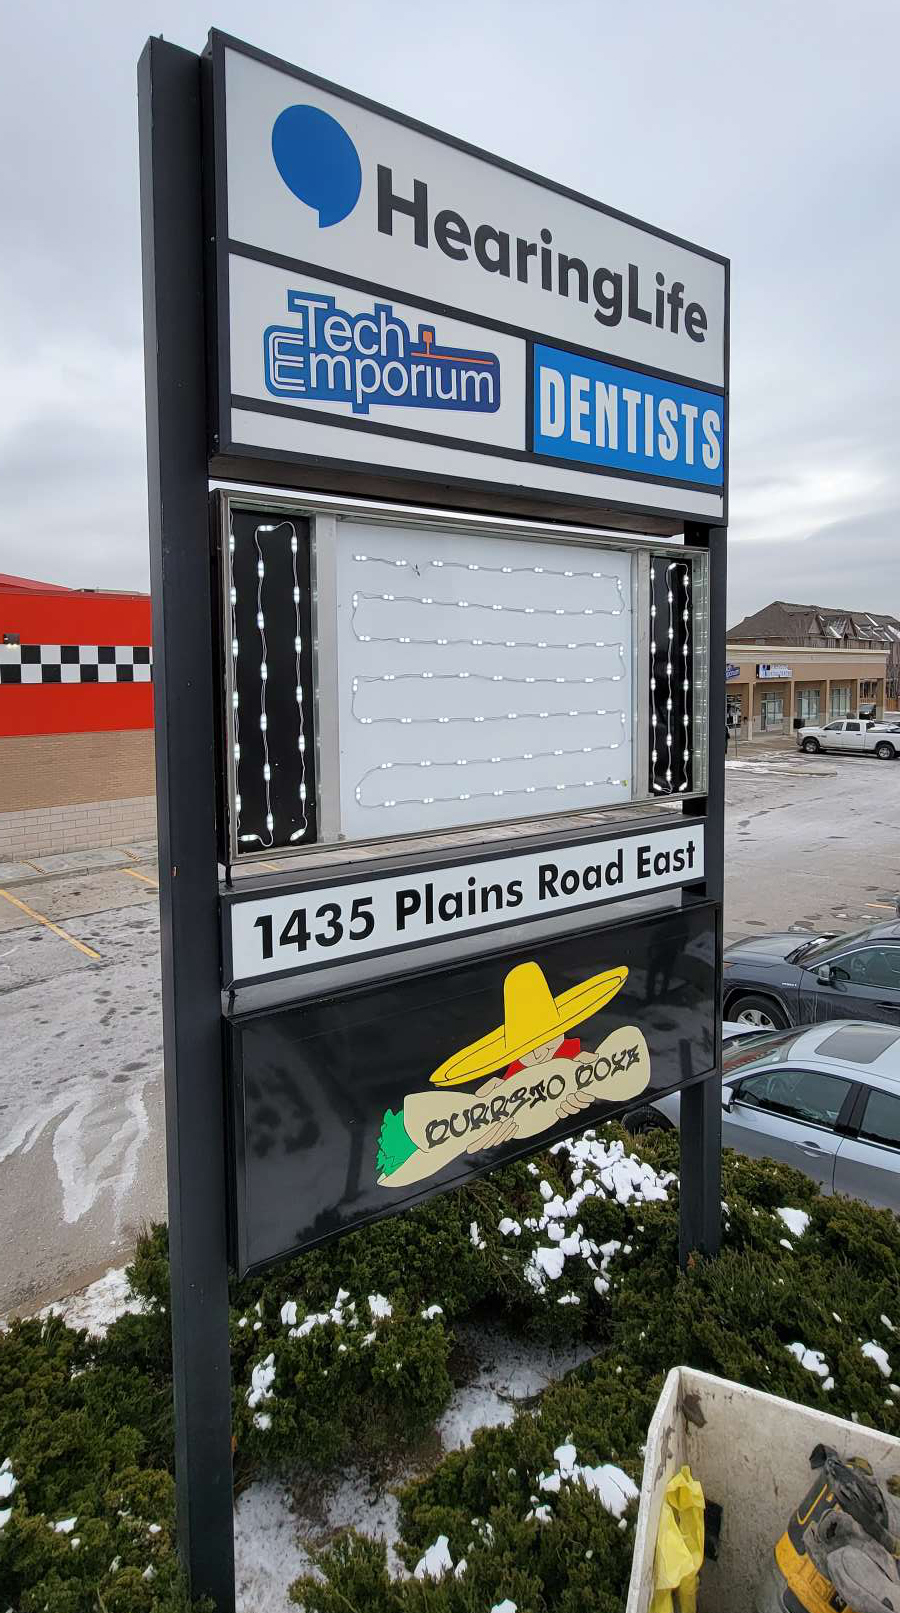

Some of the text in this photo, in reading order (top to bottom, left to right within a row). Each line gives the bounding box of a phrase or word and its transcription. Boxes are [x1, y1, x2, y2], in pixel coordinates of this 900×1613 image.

[377, 163, 708, 343] HearingLife
[268, 331, 494, 404] Emporium
[294, 298, 404, 358] Tech
[539, 365, 721, 470] DENTISTS
[253, 840, 696, 960] 1435 Plains Road East
